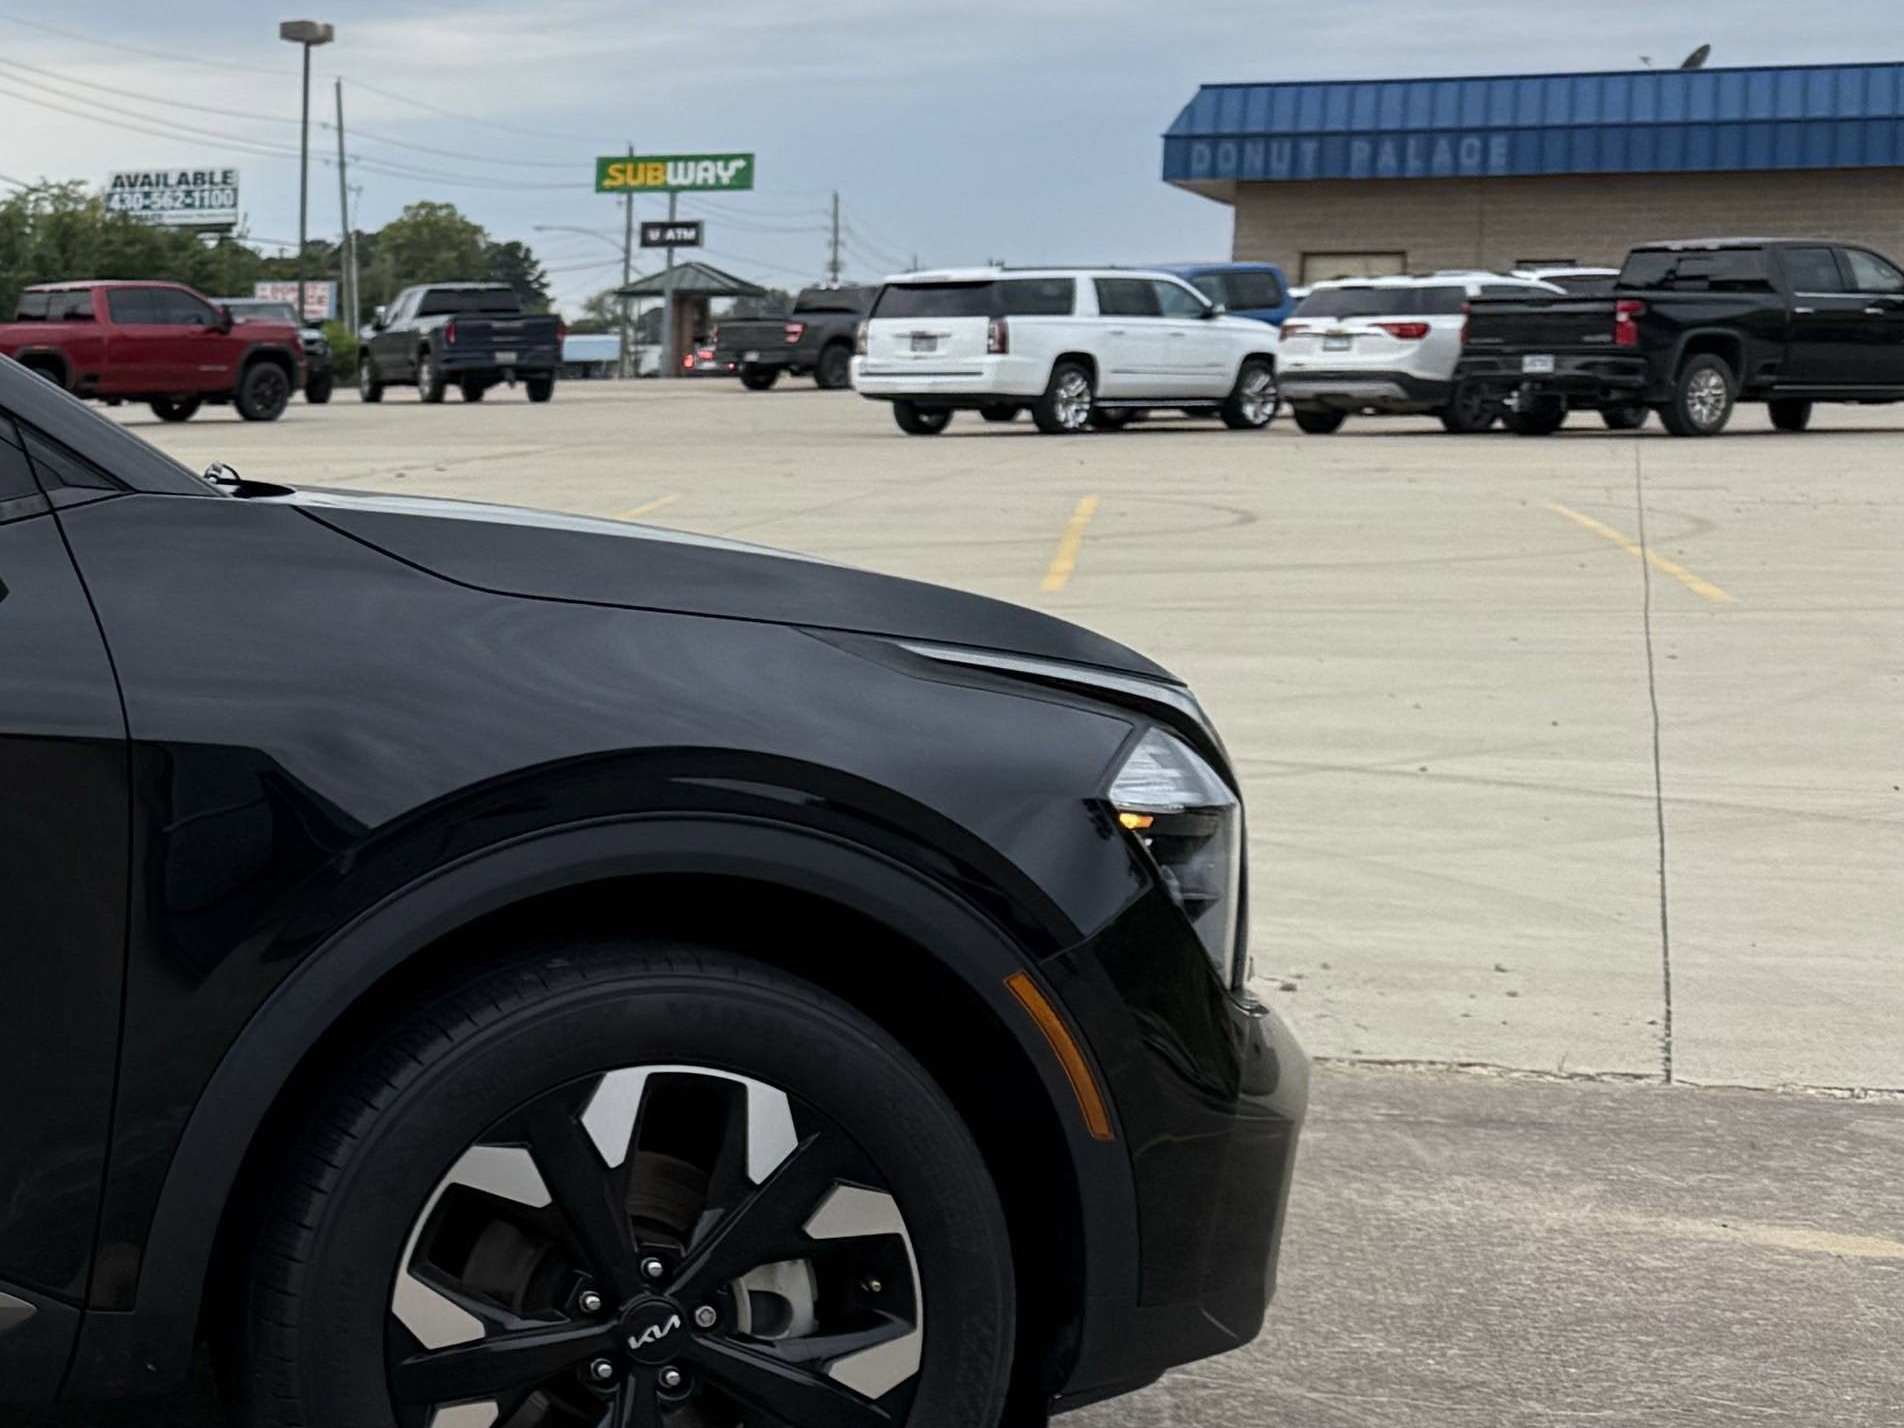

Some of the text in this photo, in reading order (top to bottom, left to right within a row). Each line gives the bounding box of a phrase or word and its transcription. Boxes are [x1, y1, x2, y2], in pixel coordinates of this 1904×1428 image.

[1193, 139, 1319, 170] DONUT
[112, 170, 234, 188] AVAILABLE
[602, 159, 747, 189] SUBWAY
[109, 190, 234, 210] 430-562-1100
[665, 228, 697, 241] ATM
